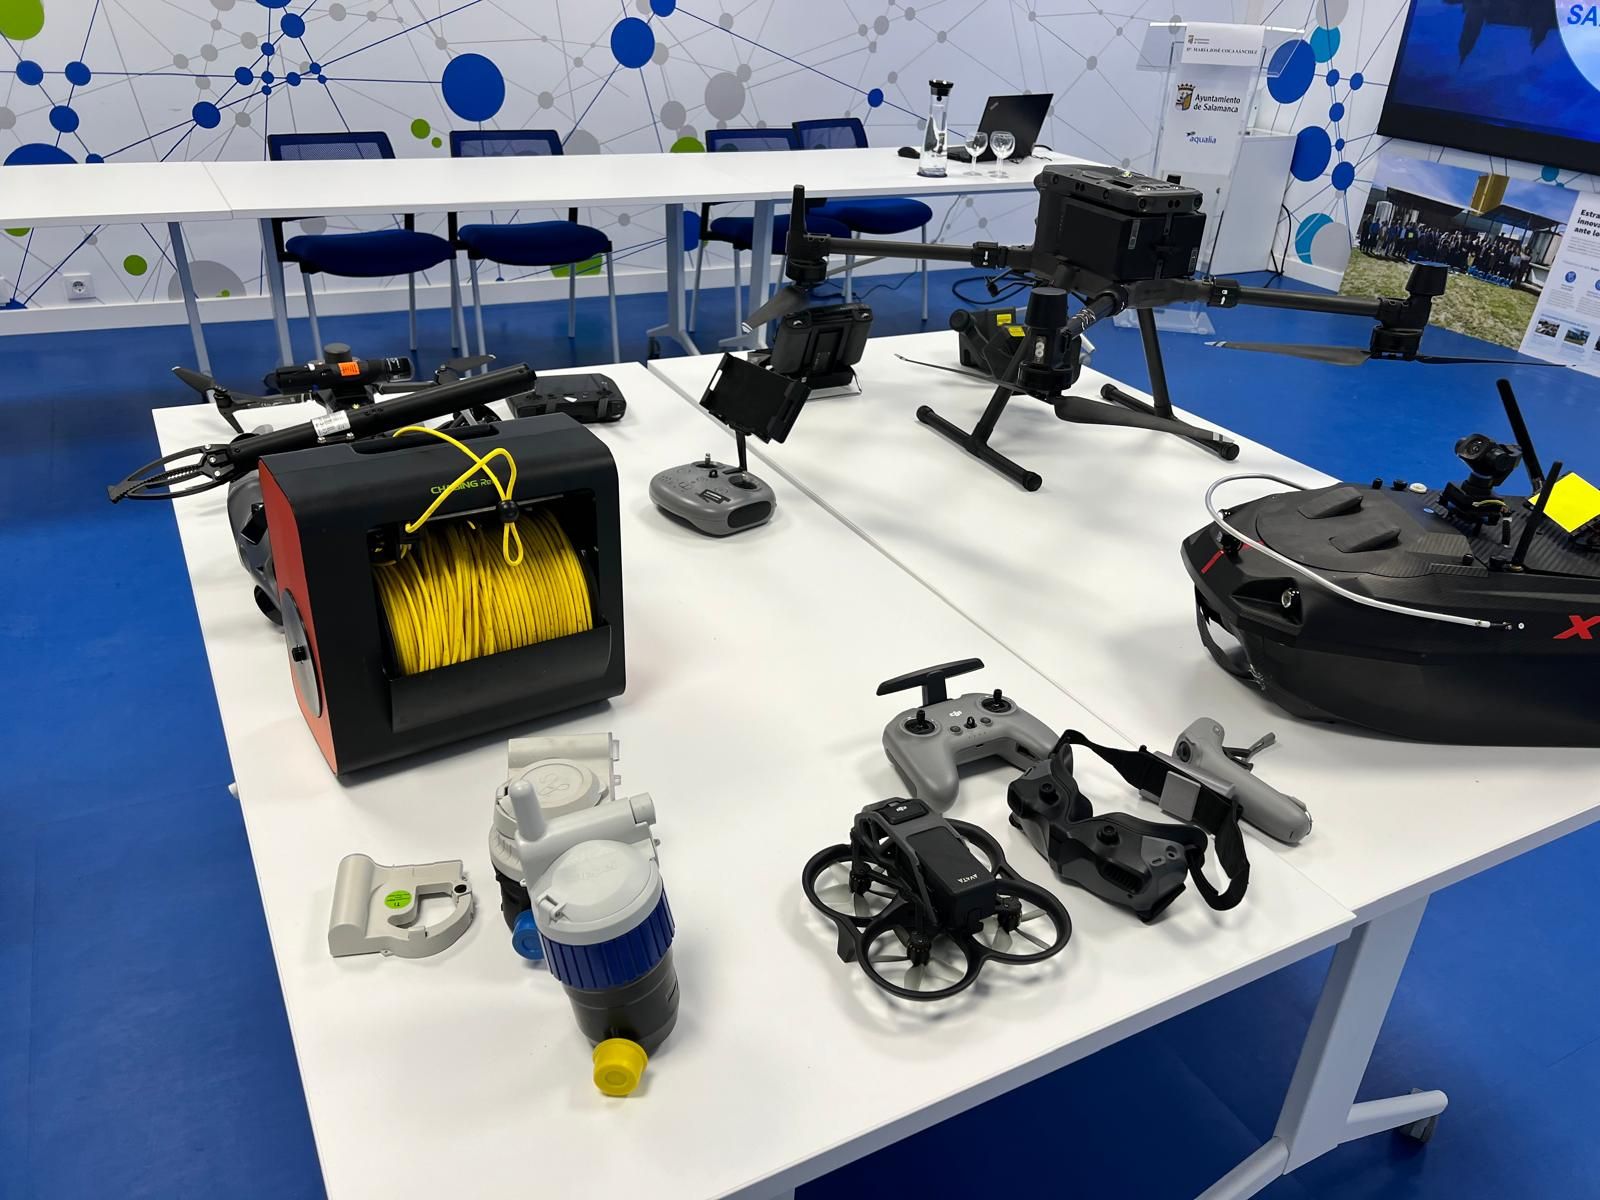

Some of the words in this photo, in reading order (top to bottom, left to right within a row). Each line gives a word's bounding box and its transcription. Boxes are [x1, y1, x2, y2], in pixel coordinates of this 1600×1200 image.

[1567, 4, 1600, 27] SA
[1194, 93, 1241, 104] Ayuntamiento
[1193, 103, 1202, 111] de
[1202, 103, 1239, 113] Salamanca
[1189, 135, 1217, 144] aqualia
[1574, 227, 1592, 235] ante
[1592, 229, 1600, 237] lo
[430, 479, 479, 494] CHING
[956, 873, 978, 884] AVATA
